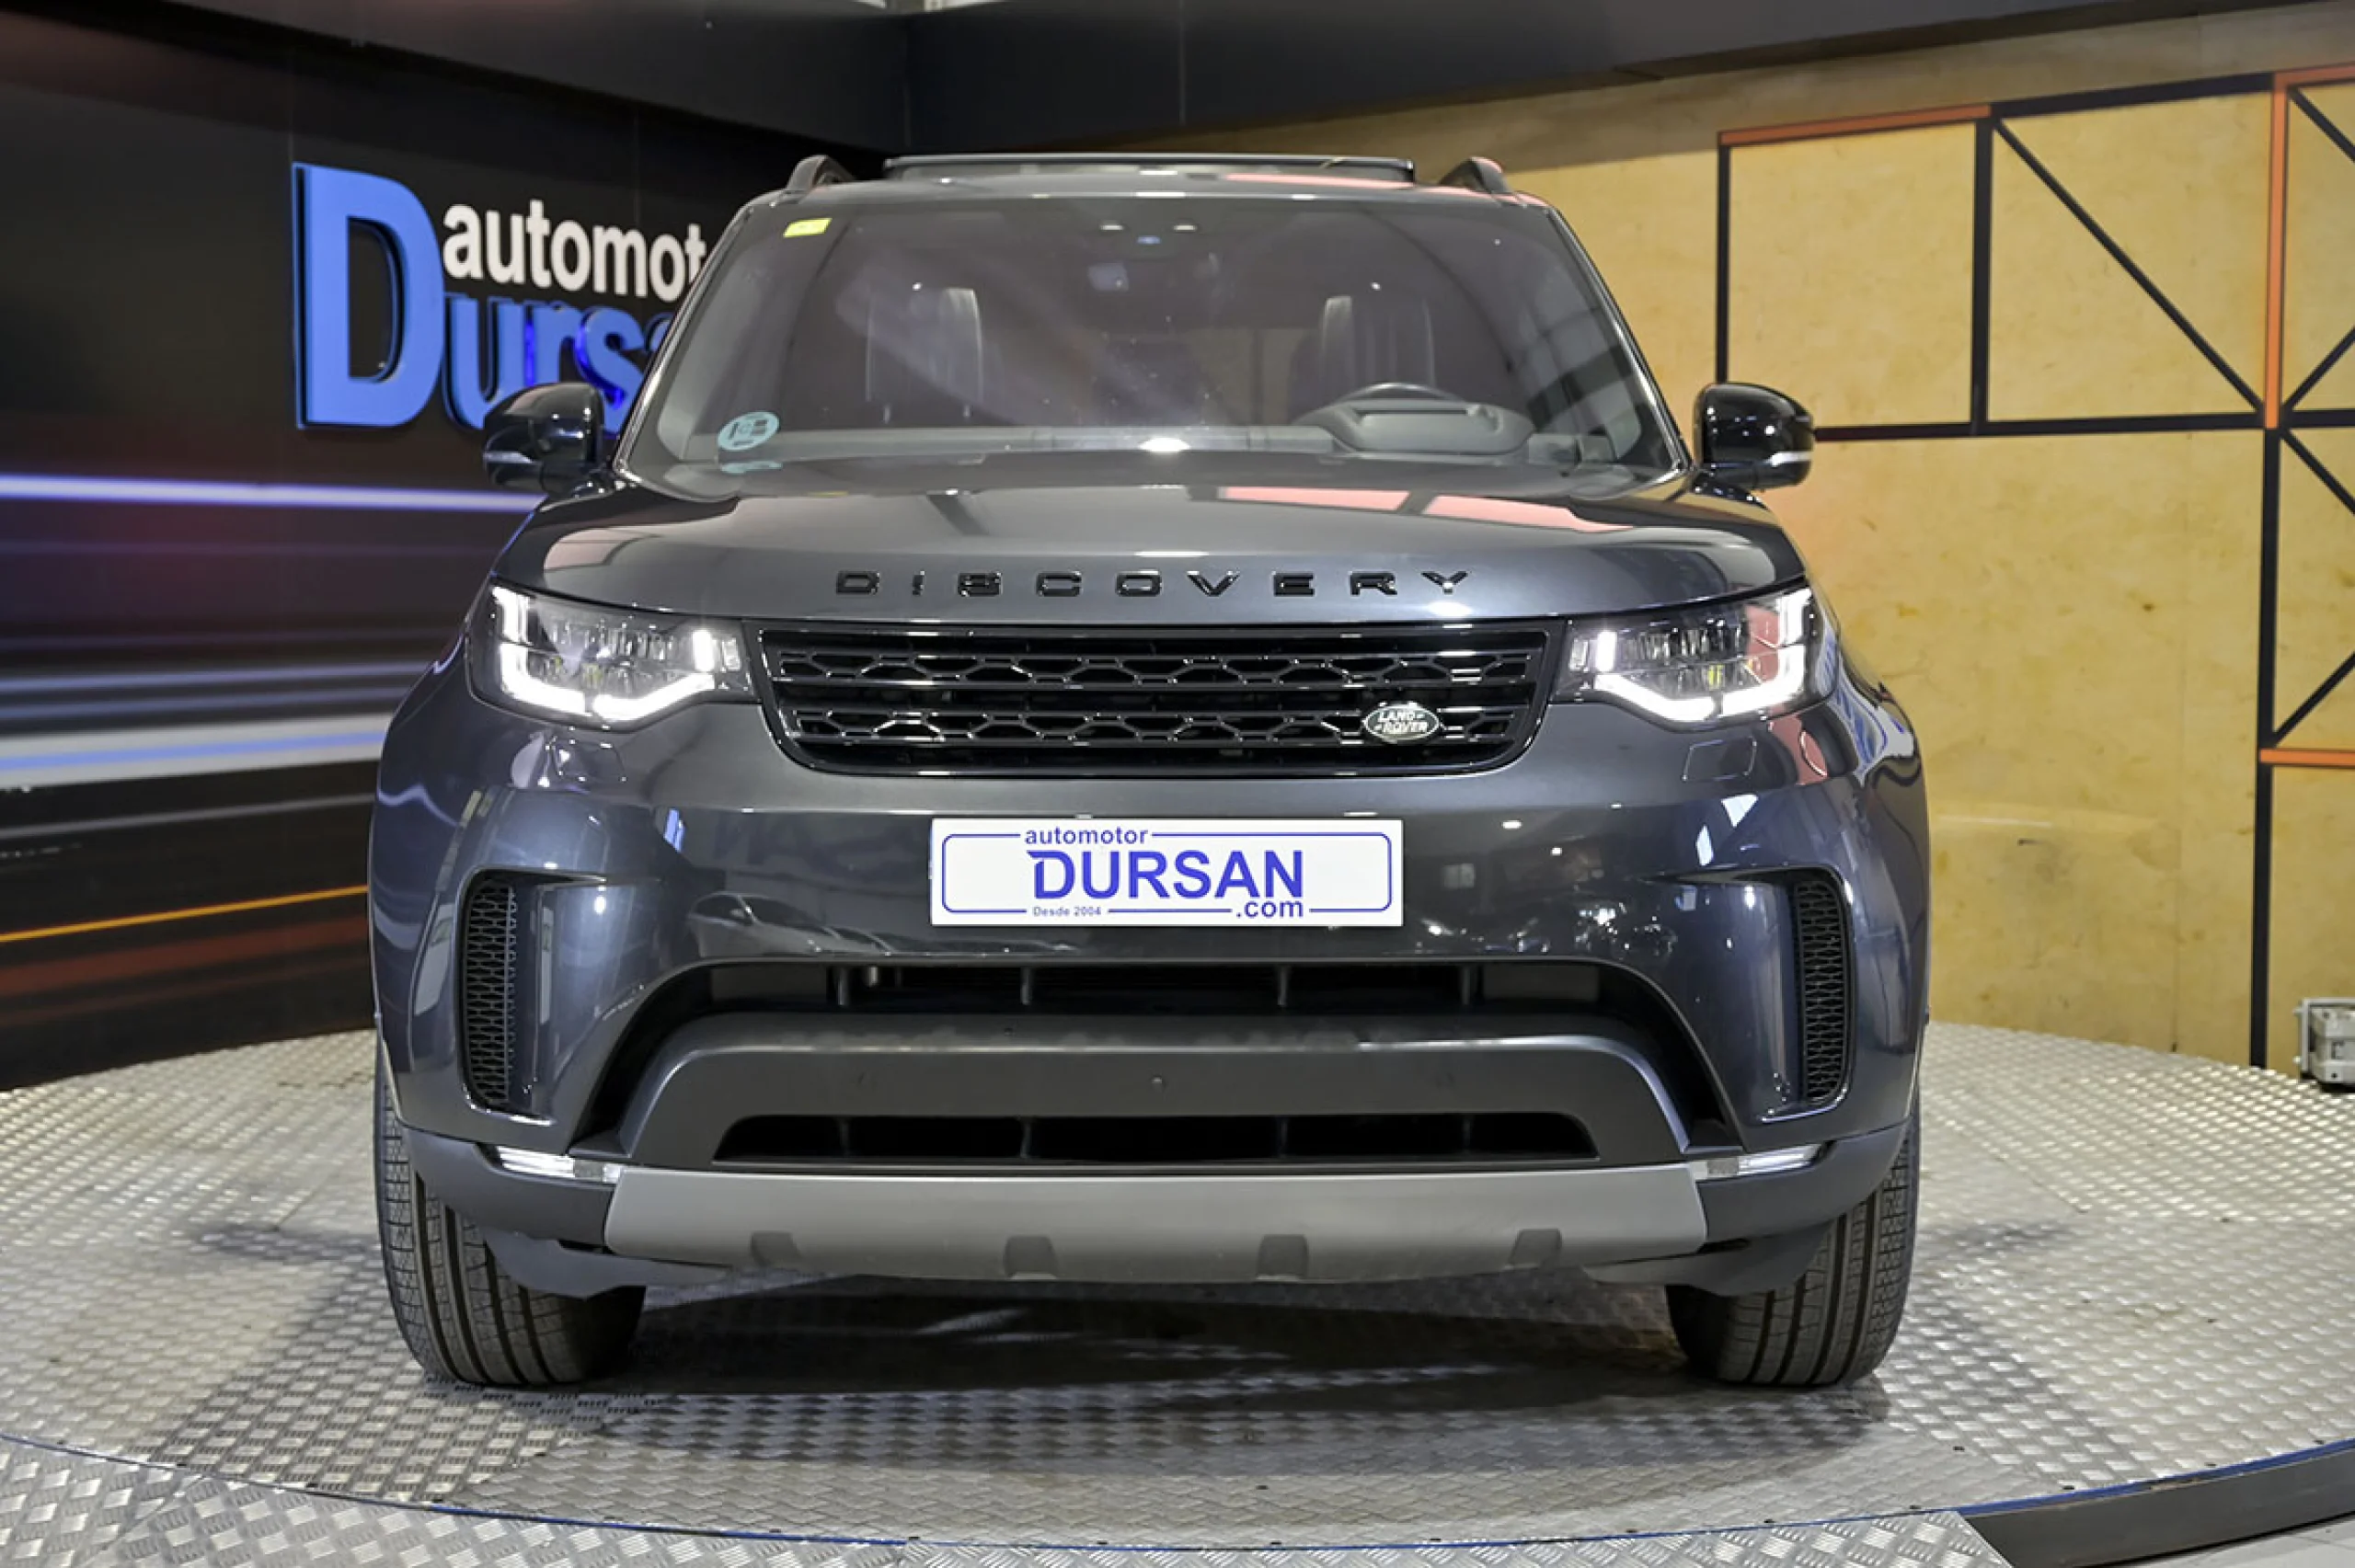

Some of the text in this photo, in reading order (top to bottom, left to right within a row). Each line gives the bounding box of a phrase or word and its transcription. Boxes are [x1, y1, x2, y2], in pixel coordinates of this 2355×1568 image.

[835, 570, 1469, 597] DISCOVERY
[1025, 826, 1149, 844] automotor
[1027, 850, 1304, 899] DURSAN
[1032, 906, 1102, 918] Desde 2004
[1235, 900, 1304, 919] .com
